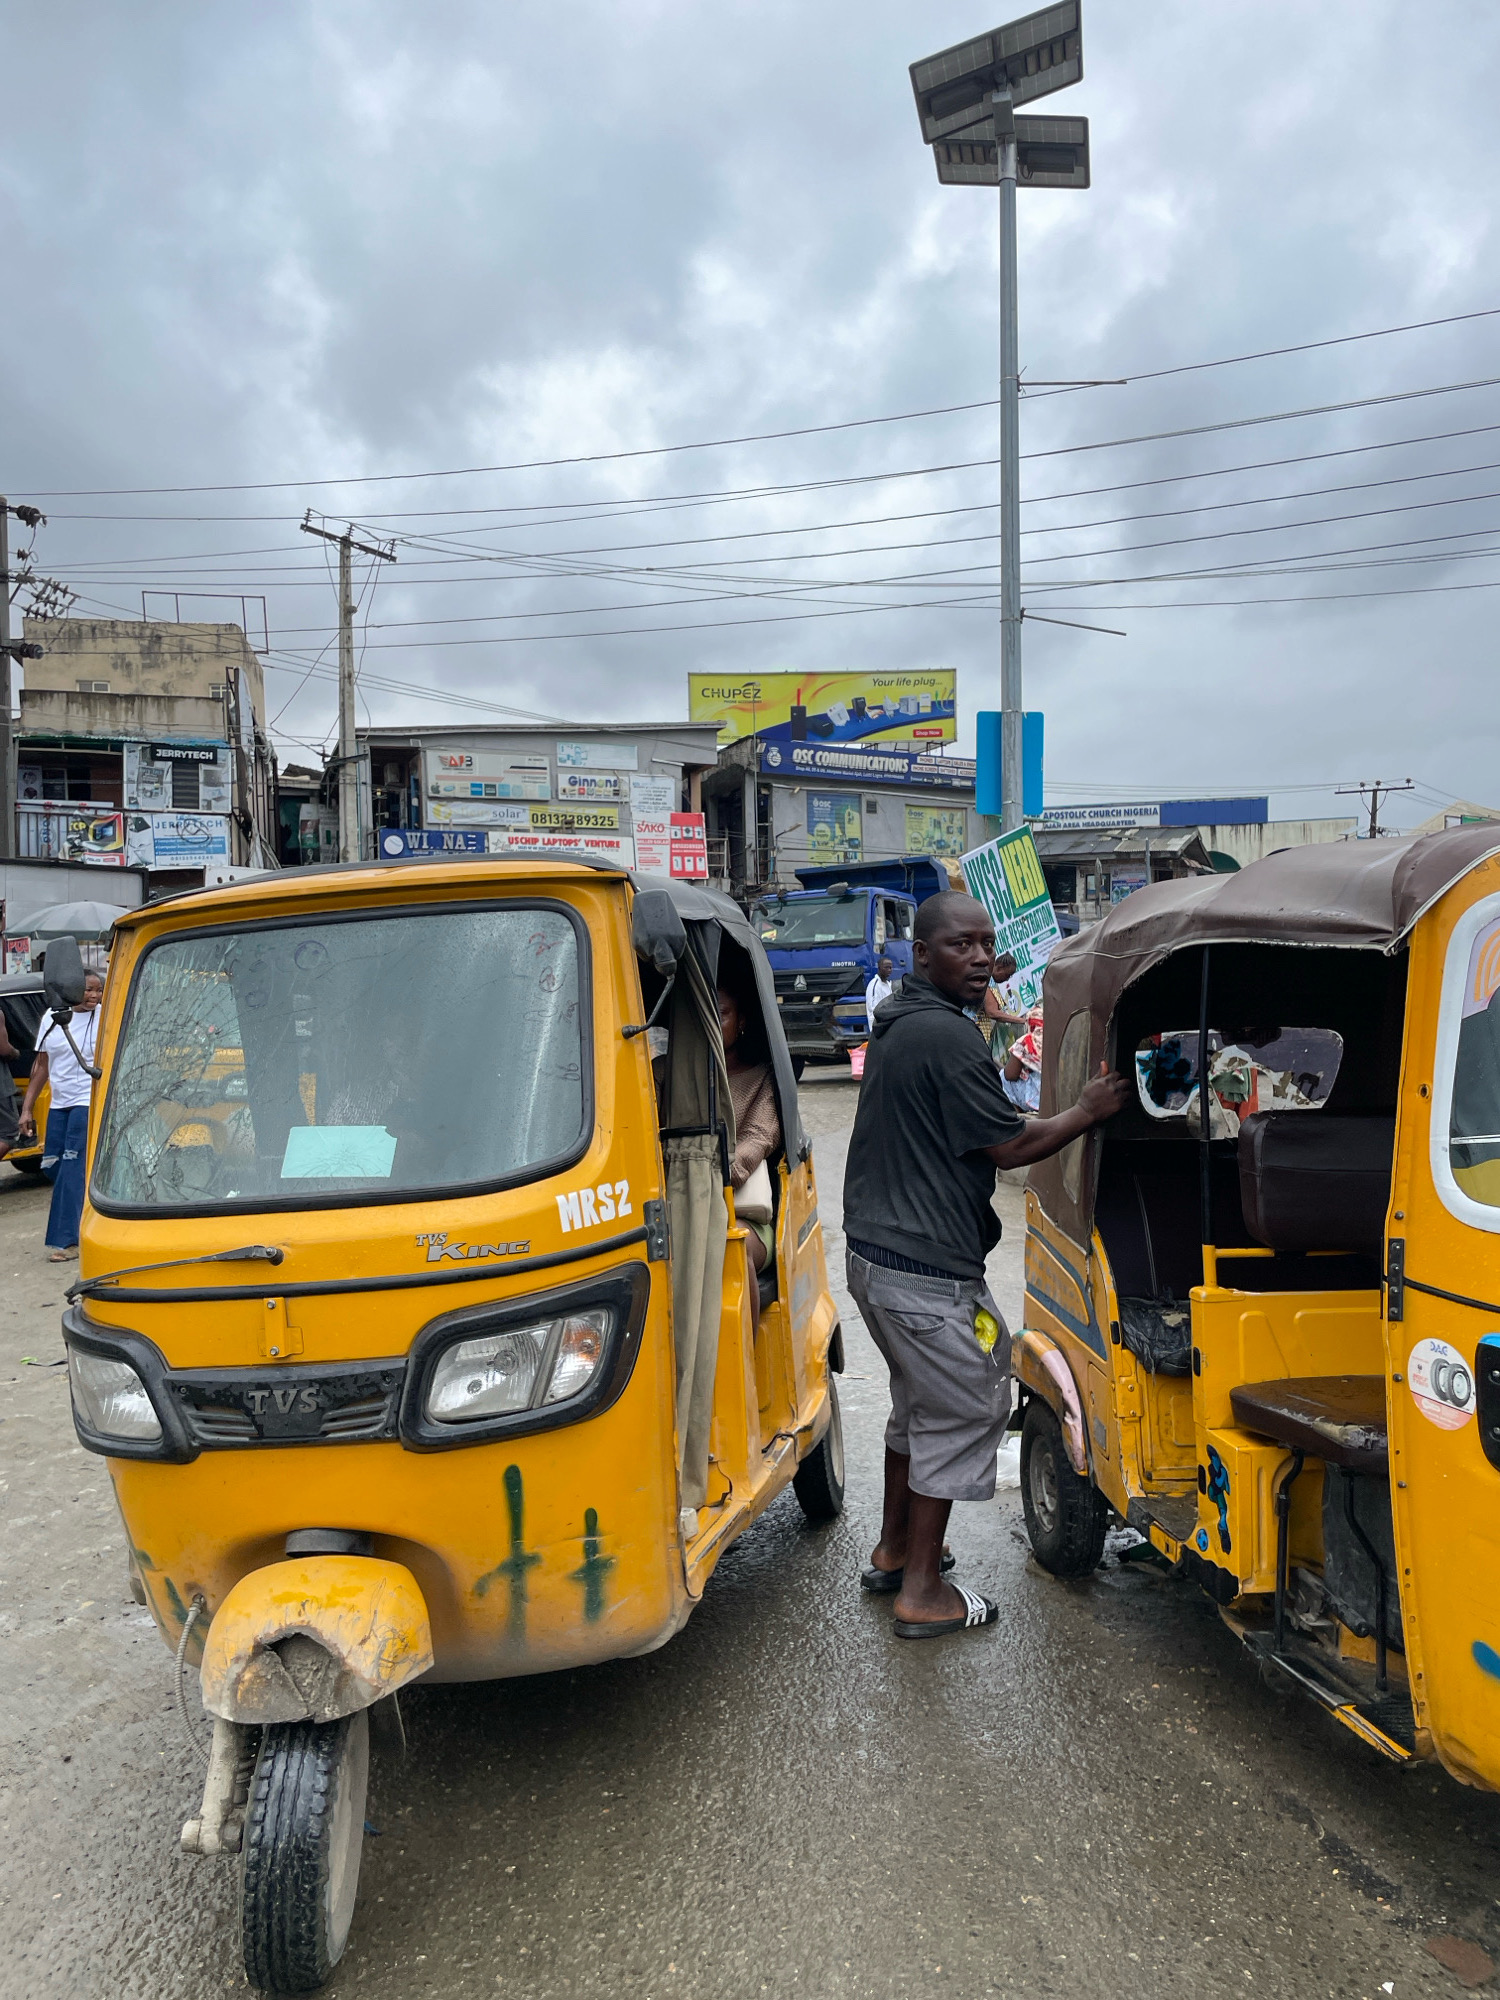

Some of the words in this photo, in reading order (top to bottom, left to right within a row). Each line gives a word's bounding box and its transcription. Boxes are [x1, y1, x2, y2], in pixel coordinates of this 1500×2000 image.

[873, 677, 895, 687] Your
[896, 677, 912, 687] life
[702, 687, 762, 699] CHUPEZ
[155, 748, 214, 761] JERRYTECH
[792, 748, 815, 764] OSC
[815, 750, 909, 774] COMMUNICATIONS
[492, 808, 521, 819] solar
[1043, 809, 1087, 820] APOSTOLIC
[1088, 808, 1122, 819] CHURCH
[1123, 807, 1159, 817] NIGERIA
[636, 820, 666, 833] SAKO
[1082, 819, 1137, 828] HEADQUARTERS
[585, 839, 620, 848] VENTURE
[999, 834, 1046, 909] NERD
[1008, 902, 1055, 947] REGISTRATION
[555, 1179, 633, 1234] MRS2
[415, 1232, 449, 1247] TVS
[247, 1385, 321, 1416] TVS
